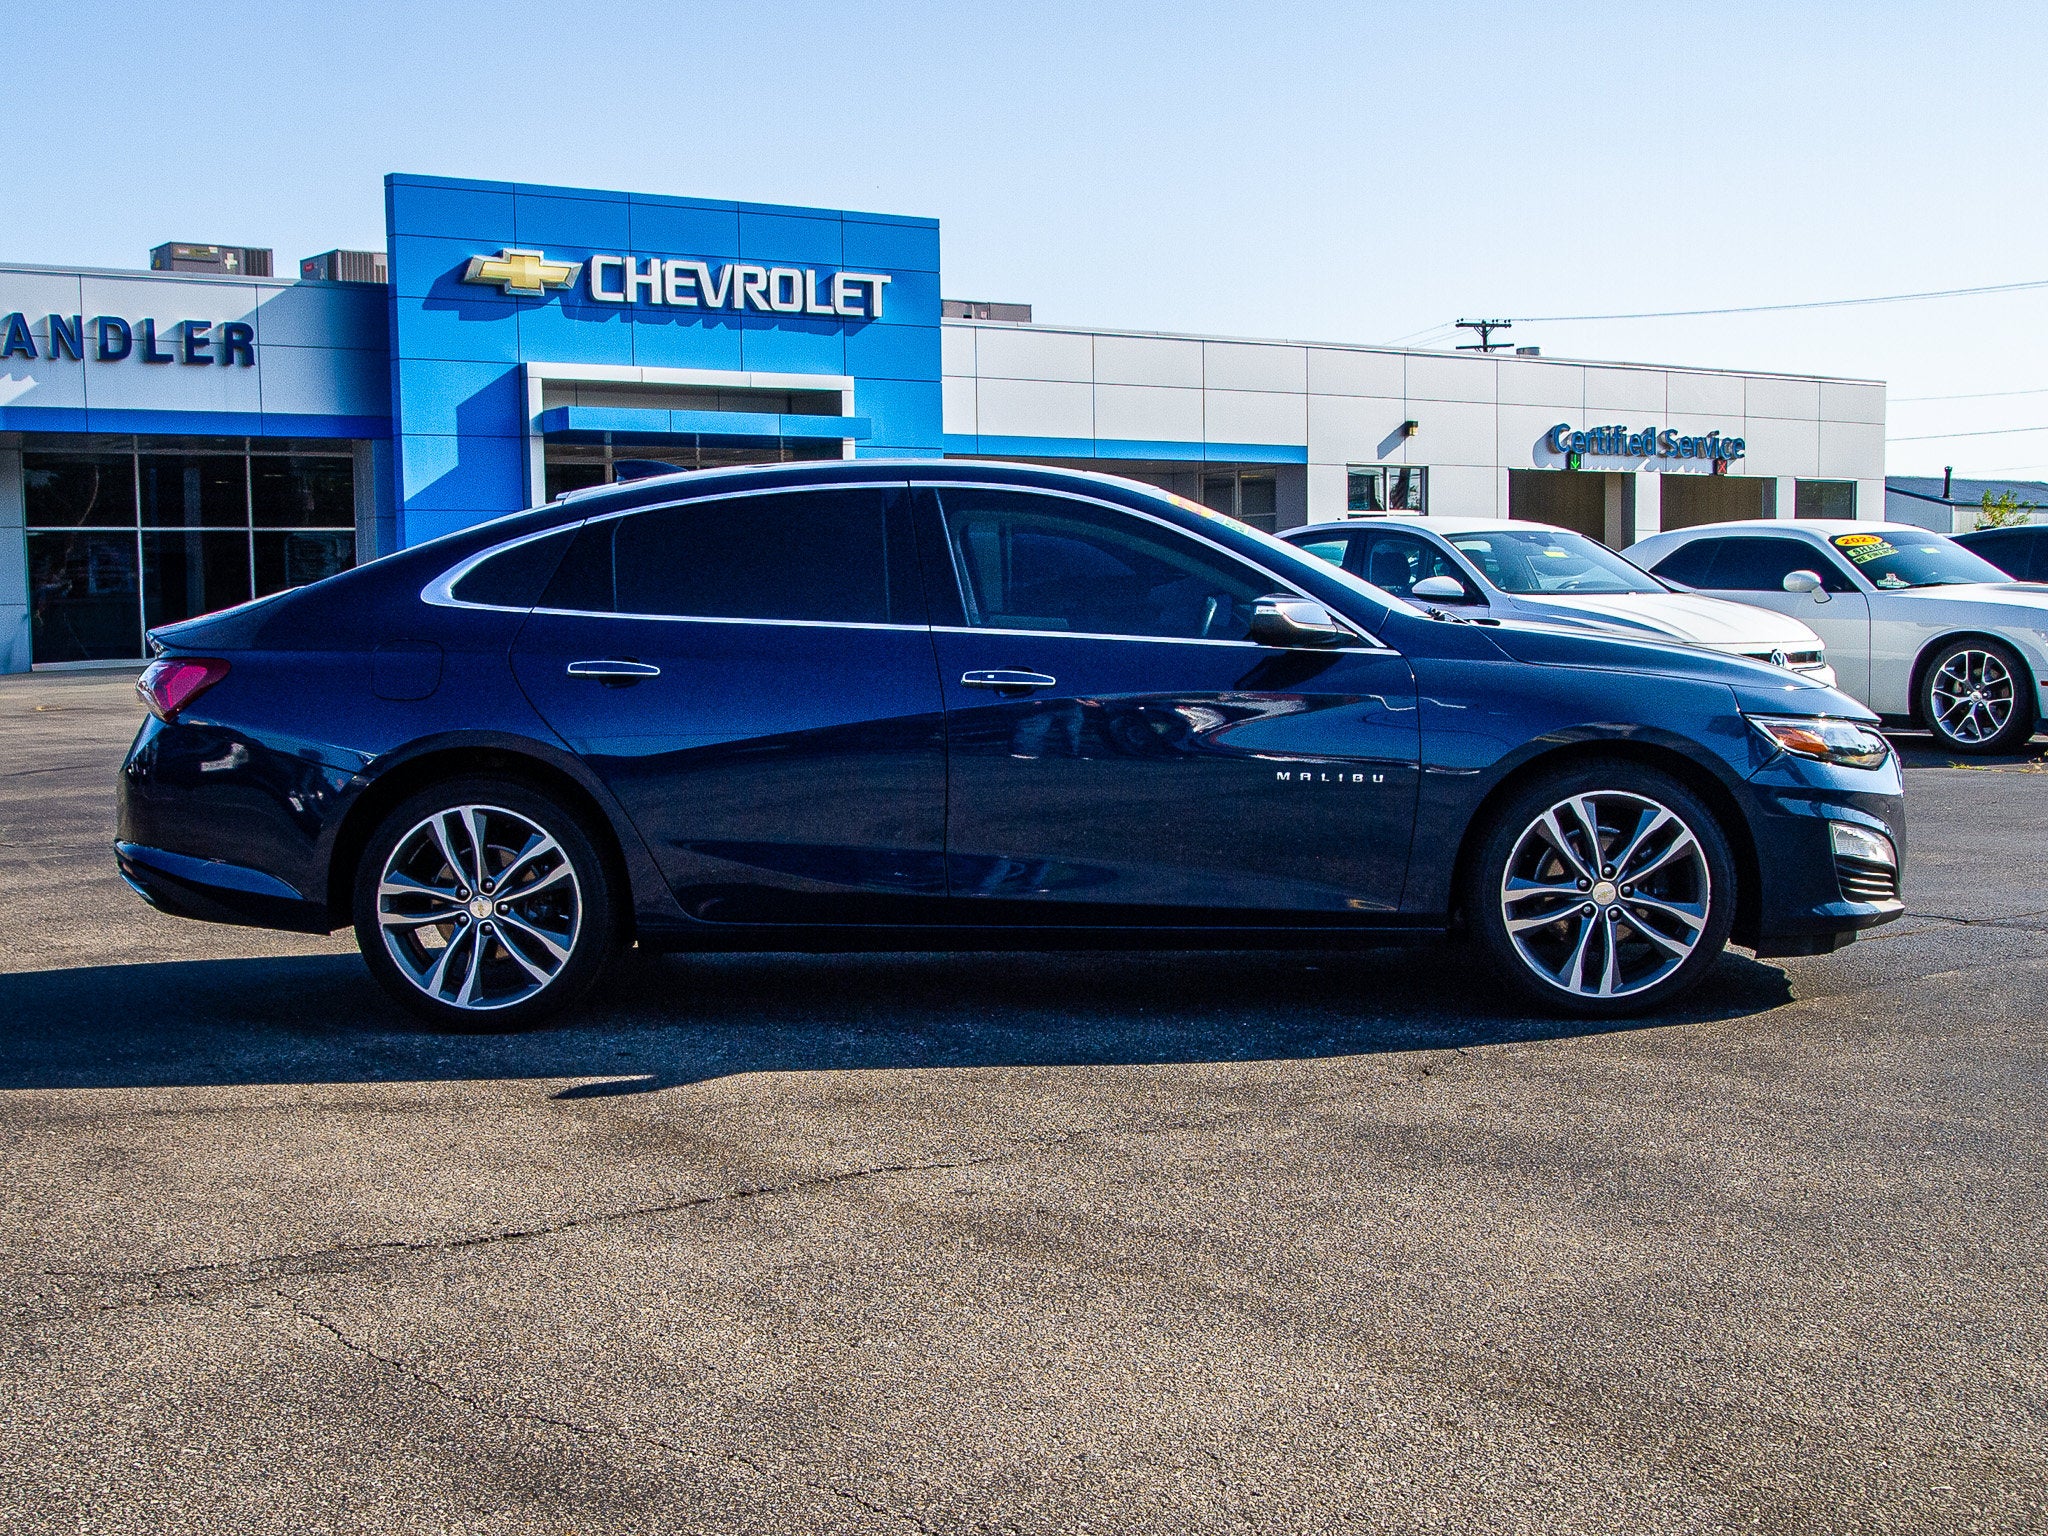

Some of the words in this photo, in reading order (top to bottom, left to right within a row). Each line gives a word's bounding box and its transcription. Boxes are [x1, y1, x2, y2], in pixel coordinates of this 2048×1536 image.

[590, 255, 892, 318] CHEVROLET
[0, 312, 256, 366] ANDLER
[1552, 423, 1656, 455] Certified
[1663, 428, 1746, 459] Service
[1276, 771, 1384, 783] MALIBU
